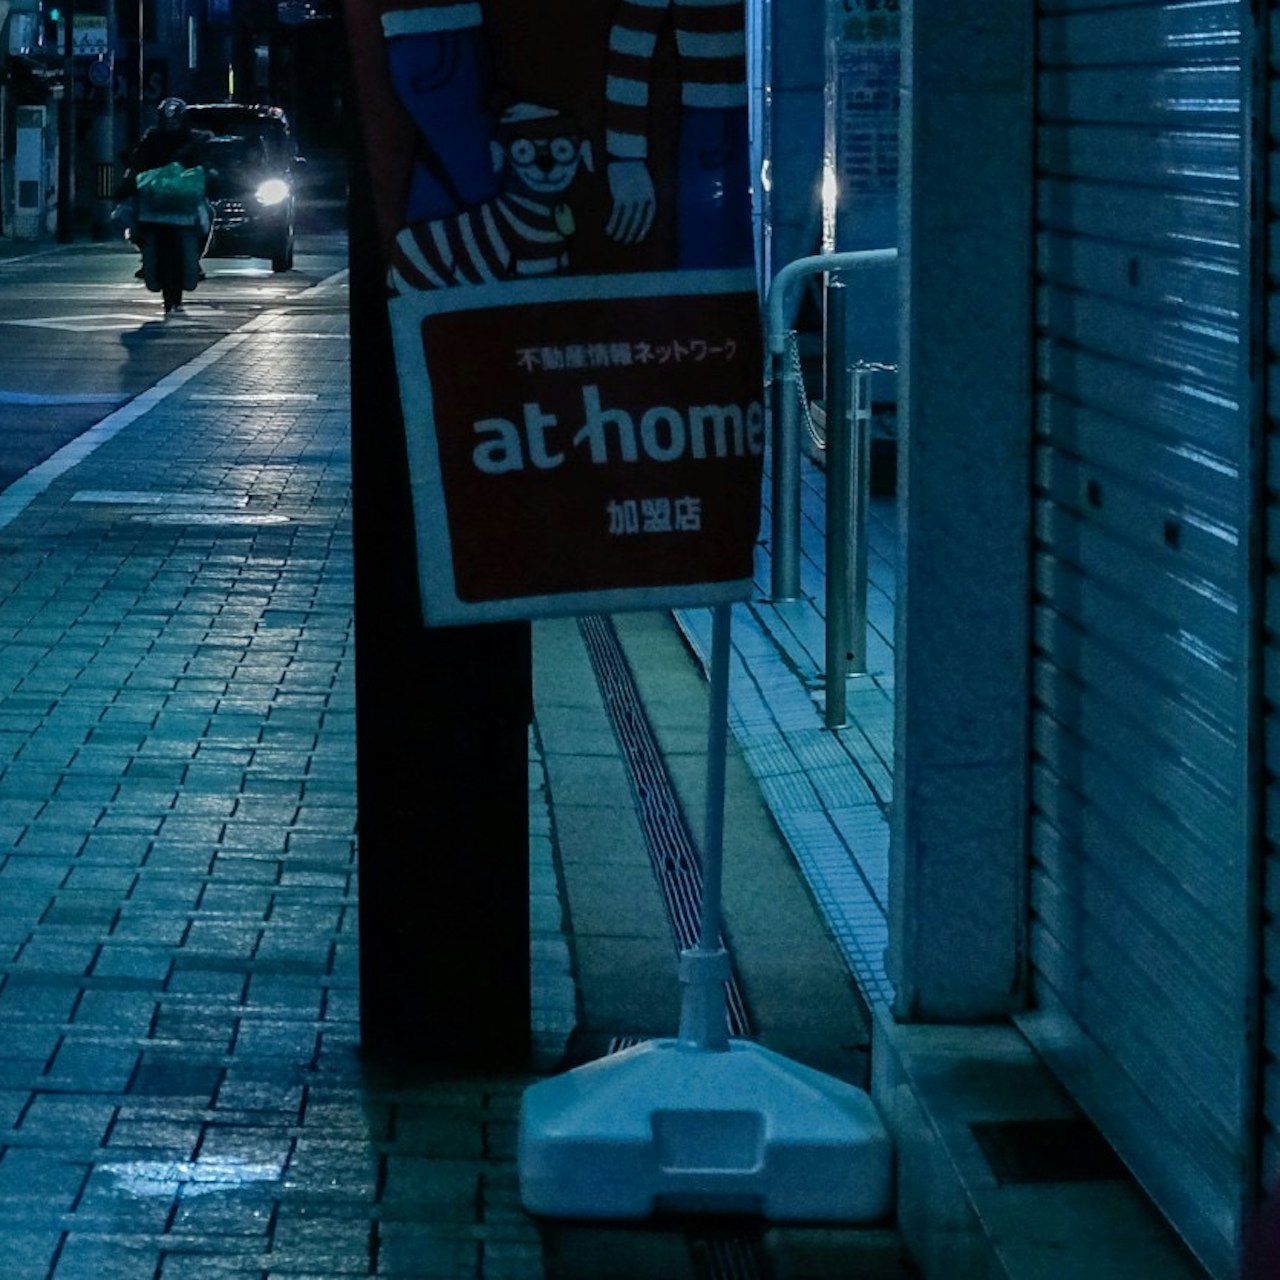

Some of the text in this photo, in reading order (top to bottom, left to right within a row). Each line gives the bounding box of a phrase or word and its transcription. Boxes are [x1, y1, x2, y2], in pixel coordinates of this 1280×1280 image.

[516, 337, 737, 373] 不動産情報ネットワーク
[471, 384, 764, 477] at home
[606, 495, 704, 537] 加盟店
